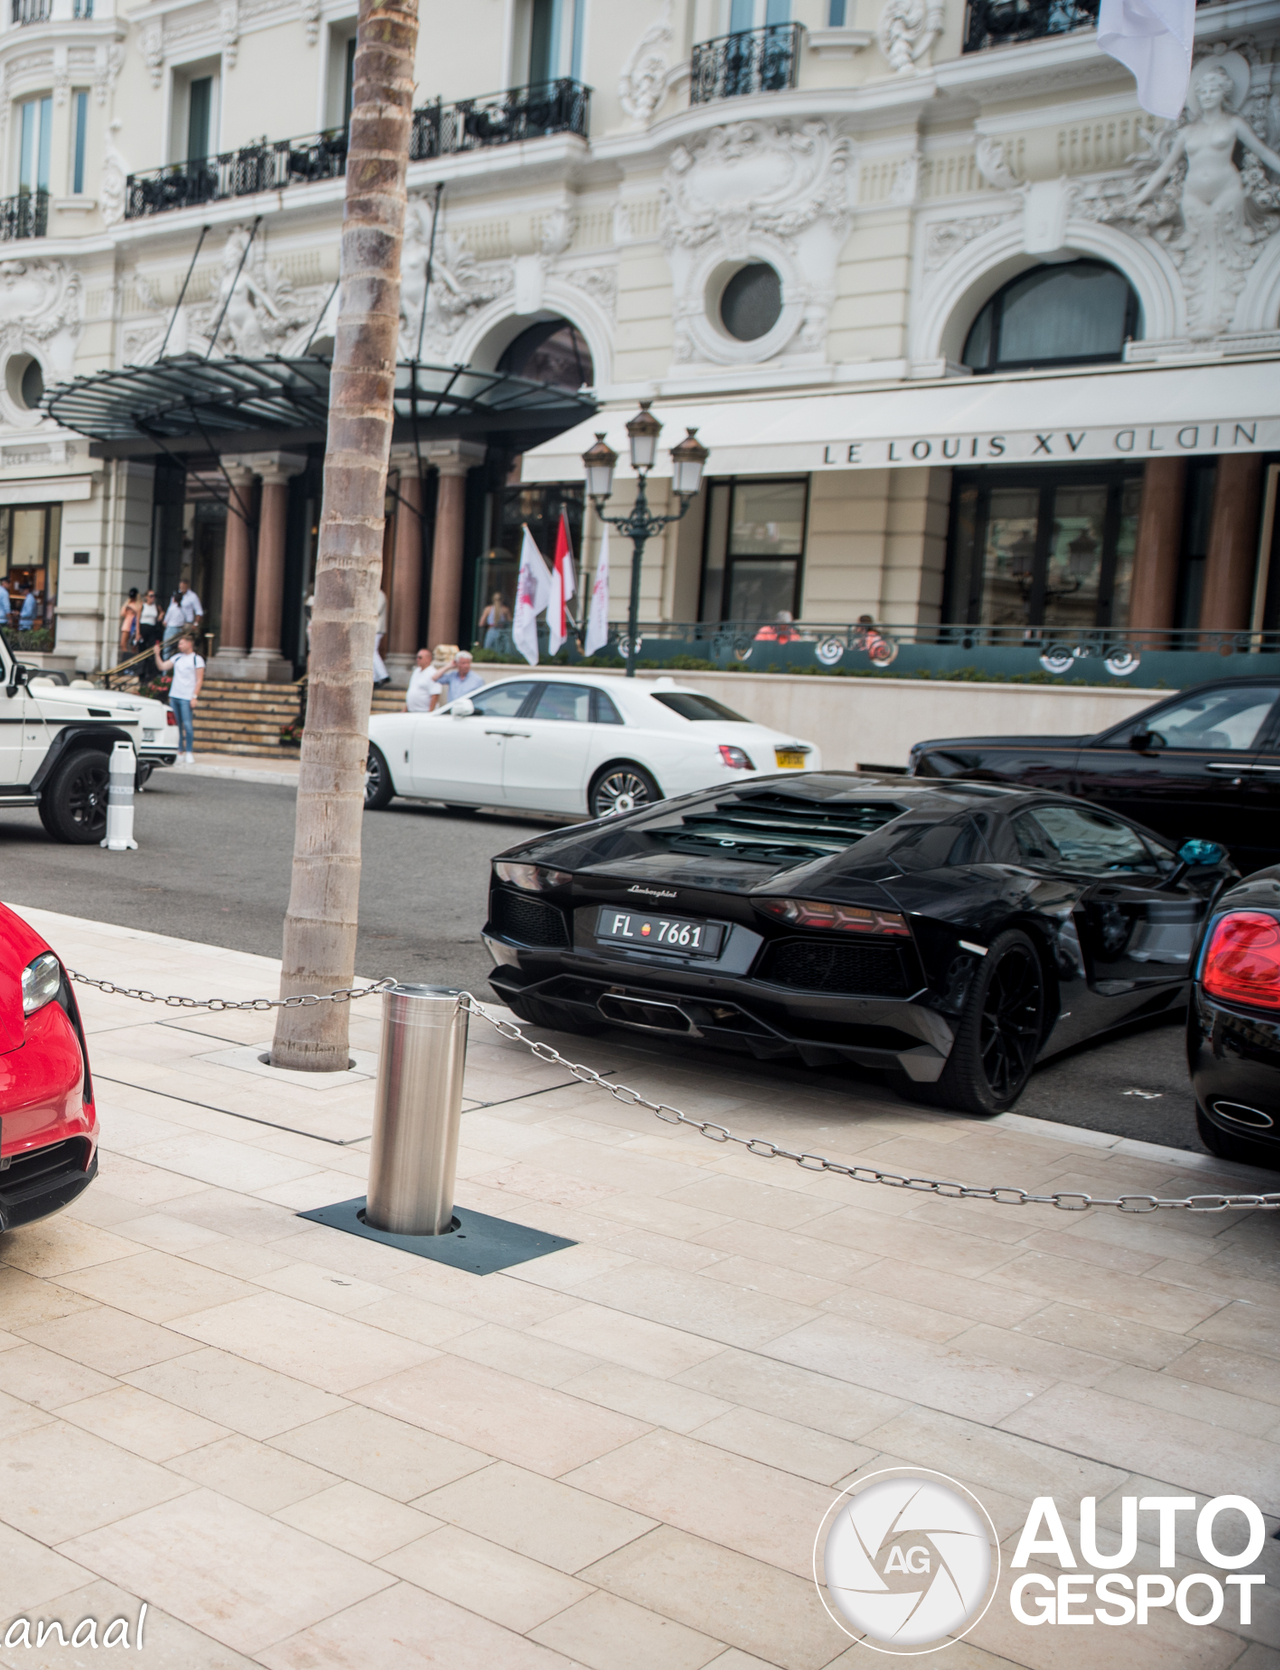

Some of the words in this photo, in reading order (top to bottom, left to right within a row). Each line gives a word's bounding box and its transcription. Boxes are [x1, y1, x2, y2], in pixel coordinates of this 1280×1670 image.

[823, 442, 863, 465] LE
[887, 435, 1006, 462] LOUIS
[1031, 431, 1086, 456] XV
[627, 885, 677, 898] Lamborghini
[612, 914, 634, 937] FL
[657, 921, 701, 947] 7661
